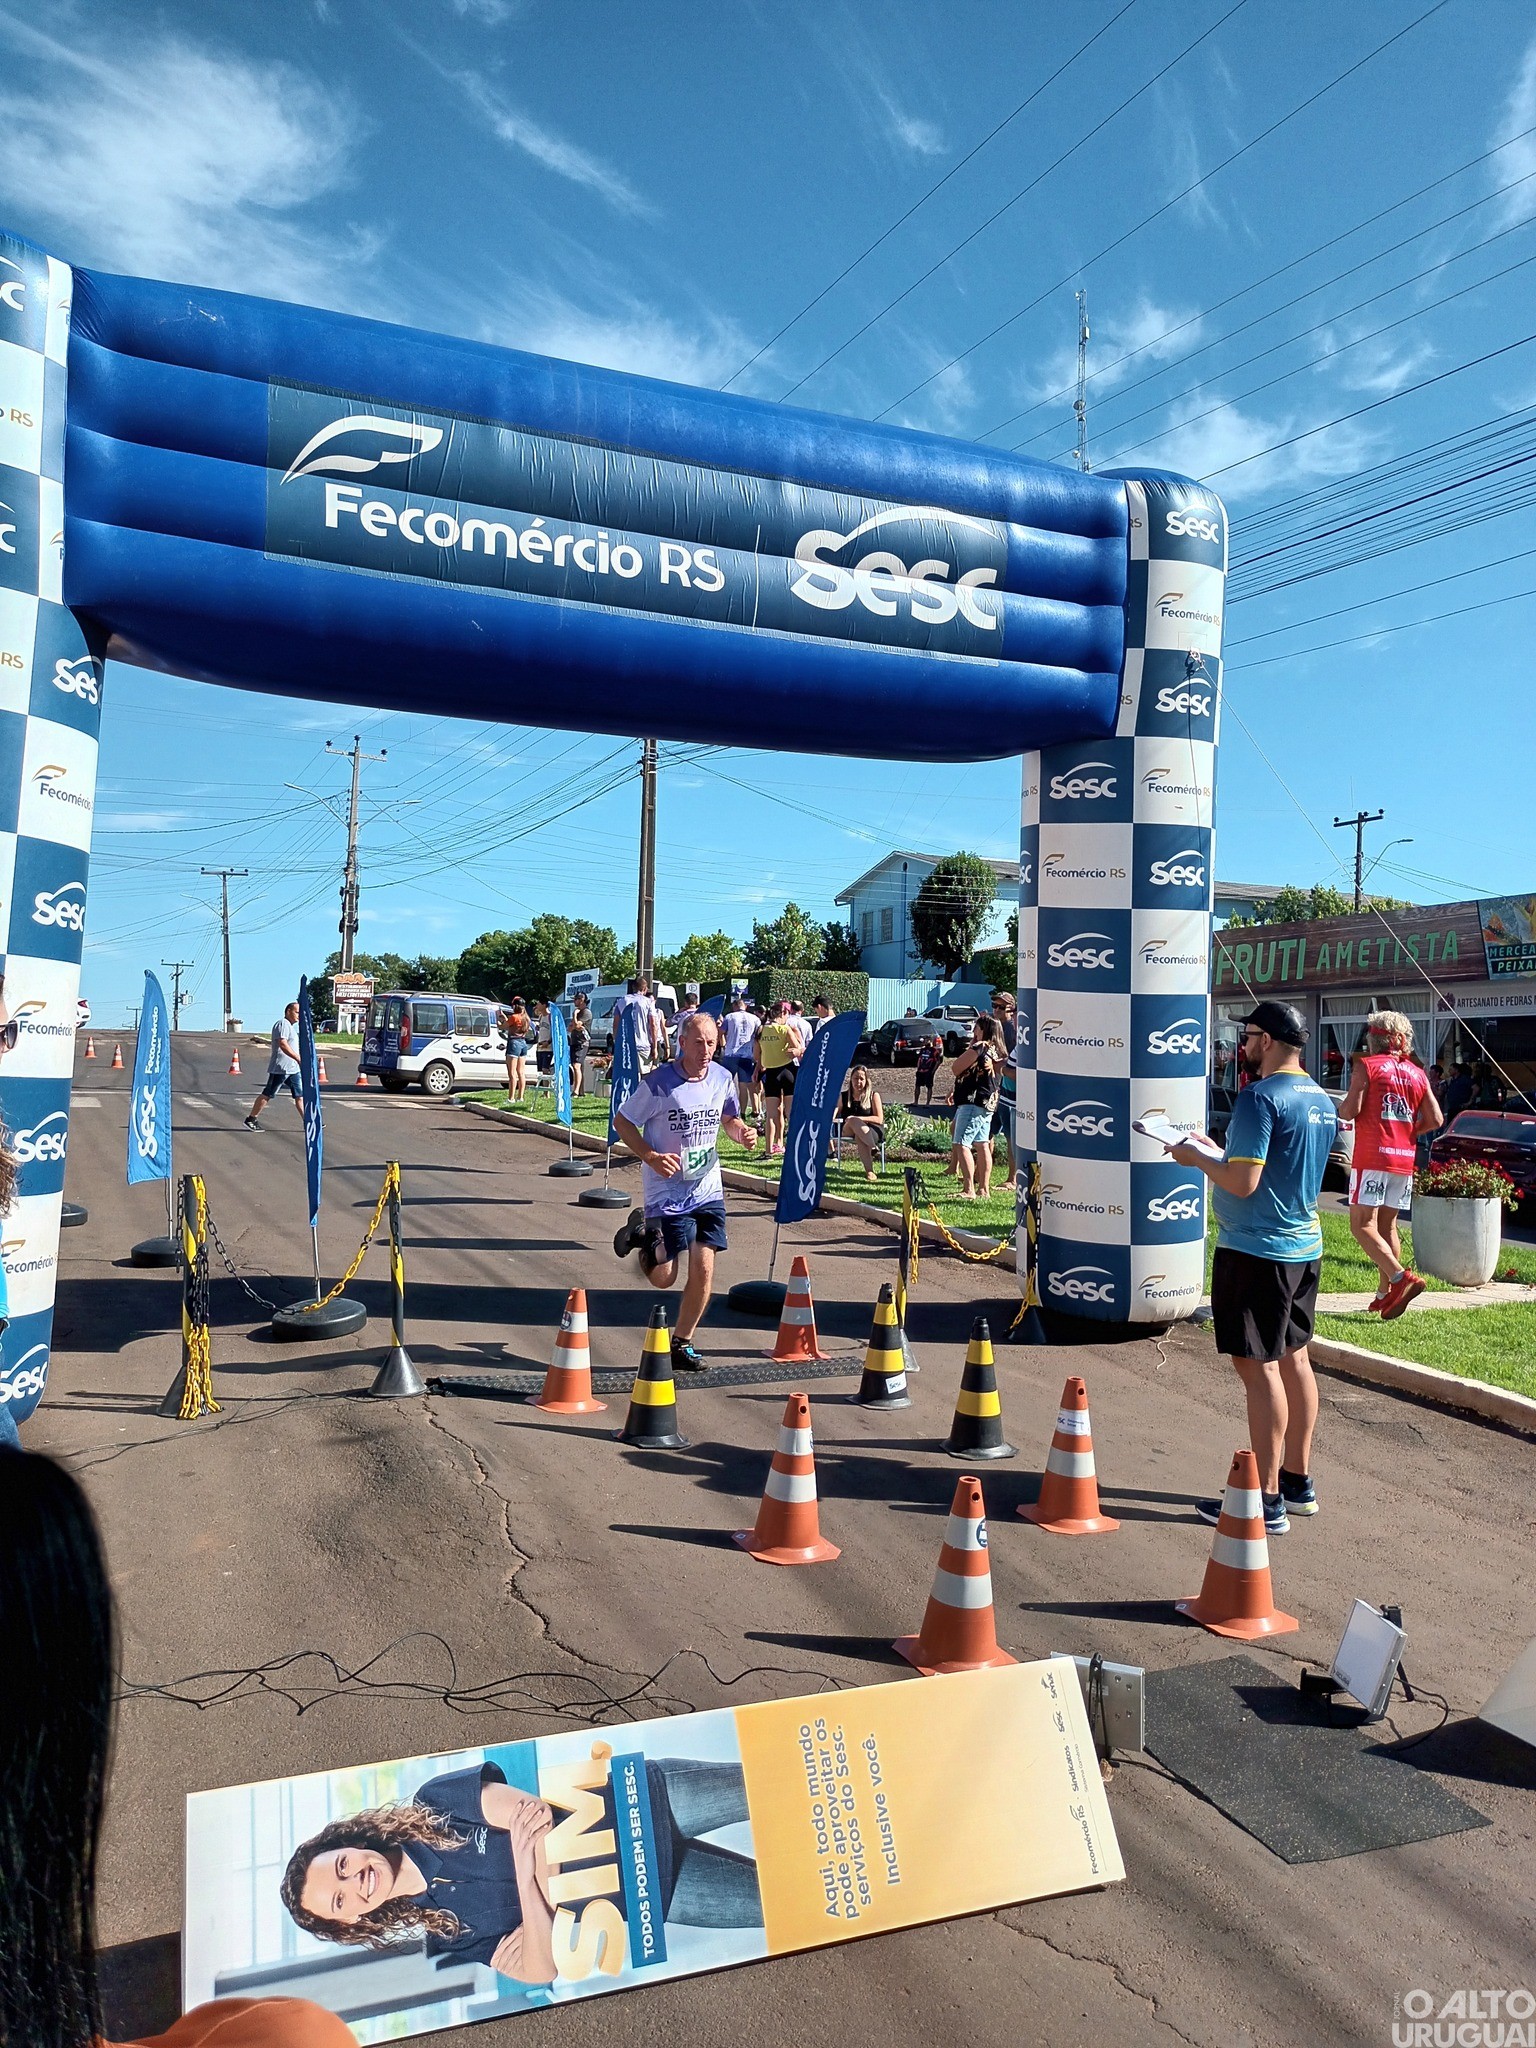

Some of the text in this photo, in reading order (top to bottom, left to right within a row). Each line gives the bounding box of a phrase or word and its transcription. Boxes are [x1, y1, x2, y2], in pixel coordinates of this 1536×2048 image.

[10, 408, 33, 428] RS
[324, 481, 727, 593] Fecomércio RS
[1165, 503, 1219, 545] Sesc
[790, 506, 999, 631] Sesc
[1161, 606, 1213, 625] Fecomércio
[1, 651, 24, 669] RS
[52, 655, 103, 707] Ses
[1155, 678, 1212, 717] Sesc
[1049, 762, 1117, 800] Sesc
[1148, 782, 1202, 797] Fecomércio
[1046, 867, 1126, 879] Fecomércio RS
[1149, 850, 1205, 887] Sesc
[1047, 932, 1115, 969] Sesc
[1145, 952, 1199, 965] Fecomércio
[1316, 930, 1459, 971] AMETISTA
[1497, 959, 1536, 972] PEIXA
[1457, 995, 1533, 1008] ARTESANATO E PEDRAS
[453, 1038, 482, 1055] Sesc
[1045, 1032, 1125, 1048] Fecomércio RS
[1147, 1018, 1202, 1055] Sesc
[811, 1031, 830, 1108] Fecomércio
[132, 1085, 158, 1160] Sesc
[670, 1121, 691, 1131] DAS
[680, 1109, 720, 1122] RÚSTICA
[1045, 1100, 1114, 1137] Sesc
[1170, 1120, 1196, 1132] mércio
[12, 1110, 69, 1163] Sesc
[795, 1120, 821, 1206] Sesc
[1045, 1196, 1125, 1215] Fecomércio RS
[1147, 1184, 1200, 1222] Sesc
[1048, 1266, 1115, 1303] Sesc
[1145, 1286, 1195, 1299] Fecomércio
[1053, 1710, 1066, 1733] Sesc
[1064, 1745, 1079, 1793] Sindicatos
[798, 1723, 841, 1919] Aqui, todo mundo
[813, 1717, 861, 1920] pode aproveitar os
[831, 1724, 872, 1907] serviços do Sesc.
[860, 1731, 901, 1885] Inclusive você.
[1077, 1804, 1085, 1819] RS
[474, 1826, 488, 1855] Sesc
[1082, 1820, 1099, 1875] Fecomércio
[539, 1740, 627, 1983] SIM,
[626, 1760, 656, 1959] TODOS PODEM SER SESC.
